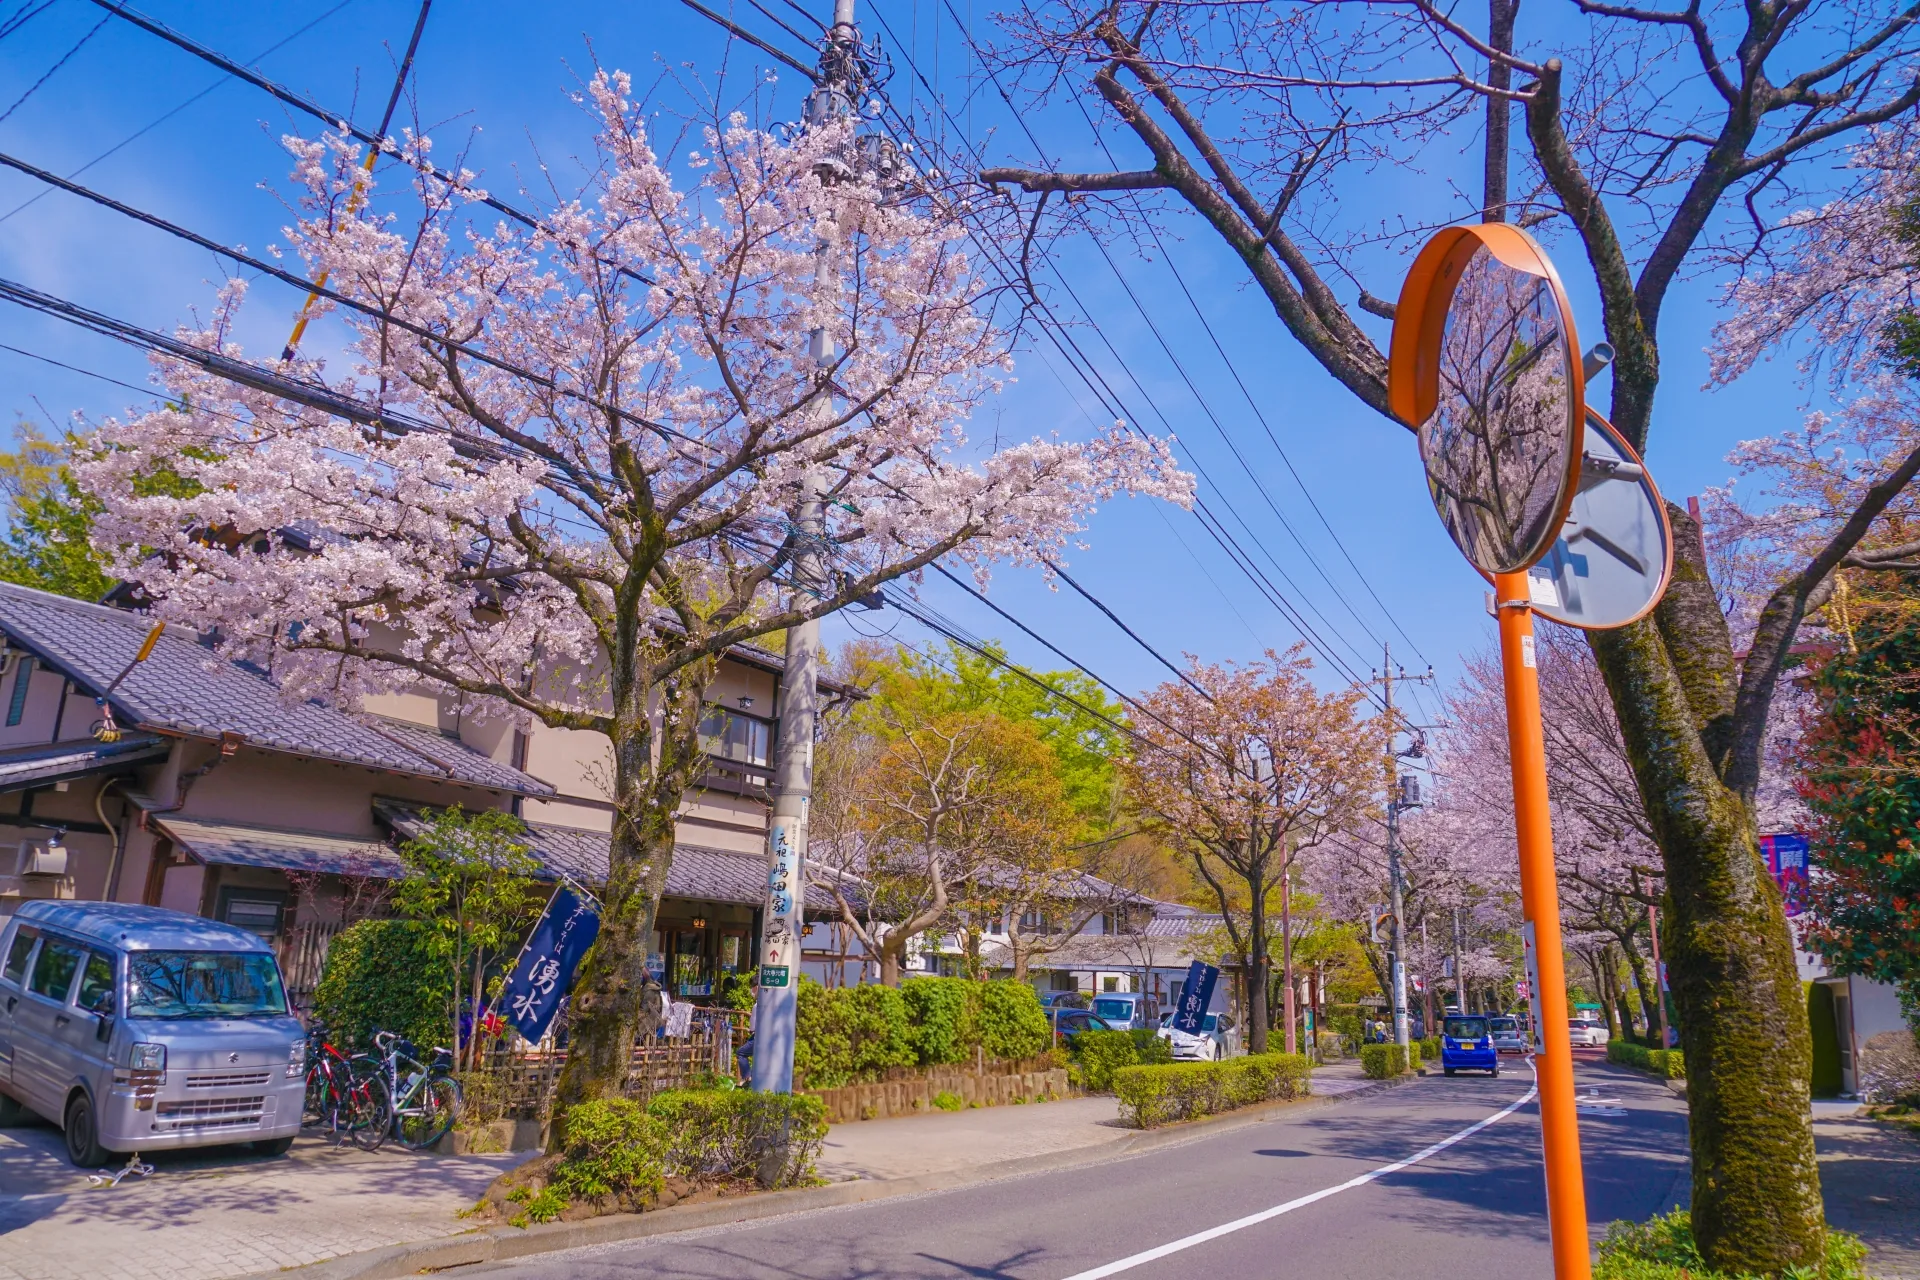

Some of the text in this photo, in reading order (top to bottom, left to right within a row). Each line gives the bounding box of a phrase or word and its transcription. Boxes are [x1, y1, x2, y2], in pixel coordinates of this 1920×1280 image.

[554, 905, 584, 955] 手打そば
[512, 954, 561, 1023] 湧水
